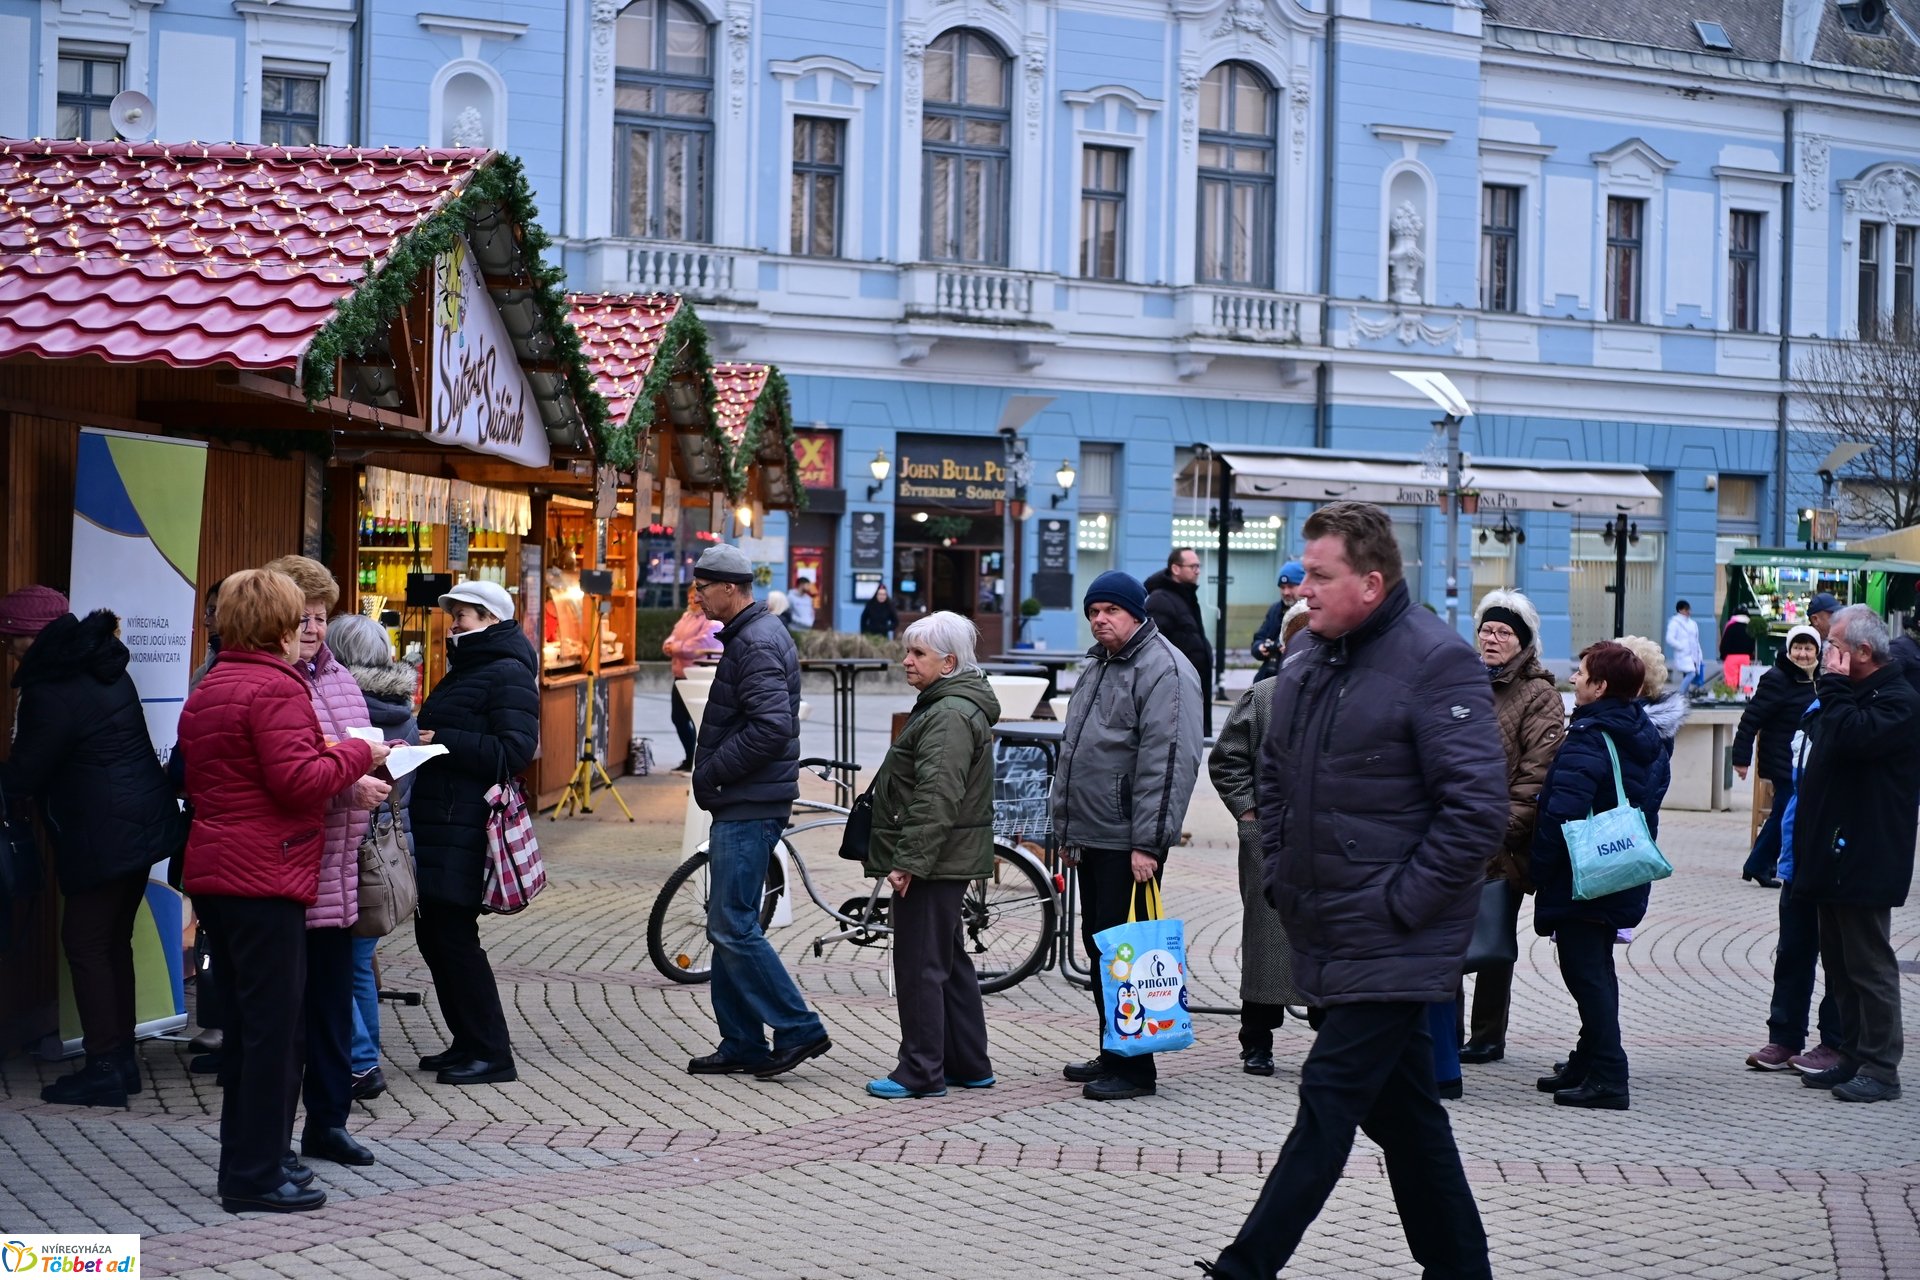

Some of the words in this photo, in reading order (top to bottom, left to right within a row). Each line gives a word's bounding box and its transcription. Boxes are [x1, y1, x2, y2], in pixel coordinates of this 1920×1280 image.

[985, 461, 1006, 482] PU
[127, 615, 169, 628] NYÍREGYHÁZA
[127, 635, 148, 645] MEGYEI
[150, 633, 166, 645] JOGÚ
[168, 633, 187, 646] VÁROS
[130, 650, 181, 662] NKORMÁNYZATA
[1597, 838, 1635, 856] ISANA
[1137, 976, 1178, 989] PINGVIN
